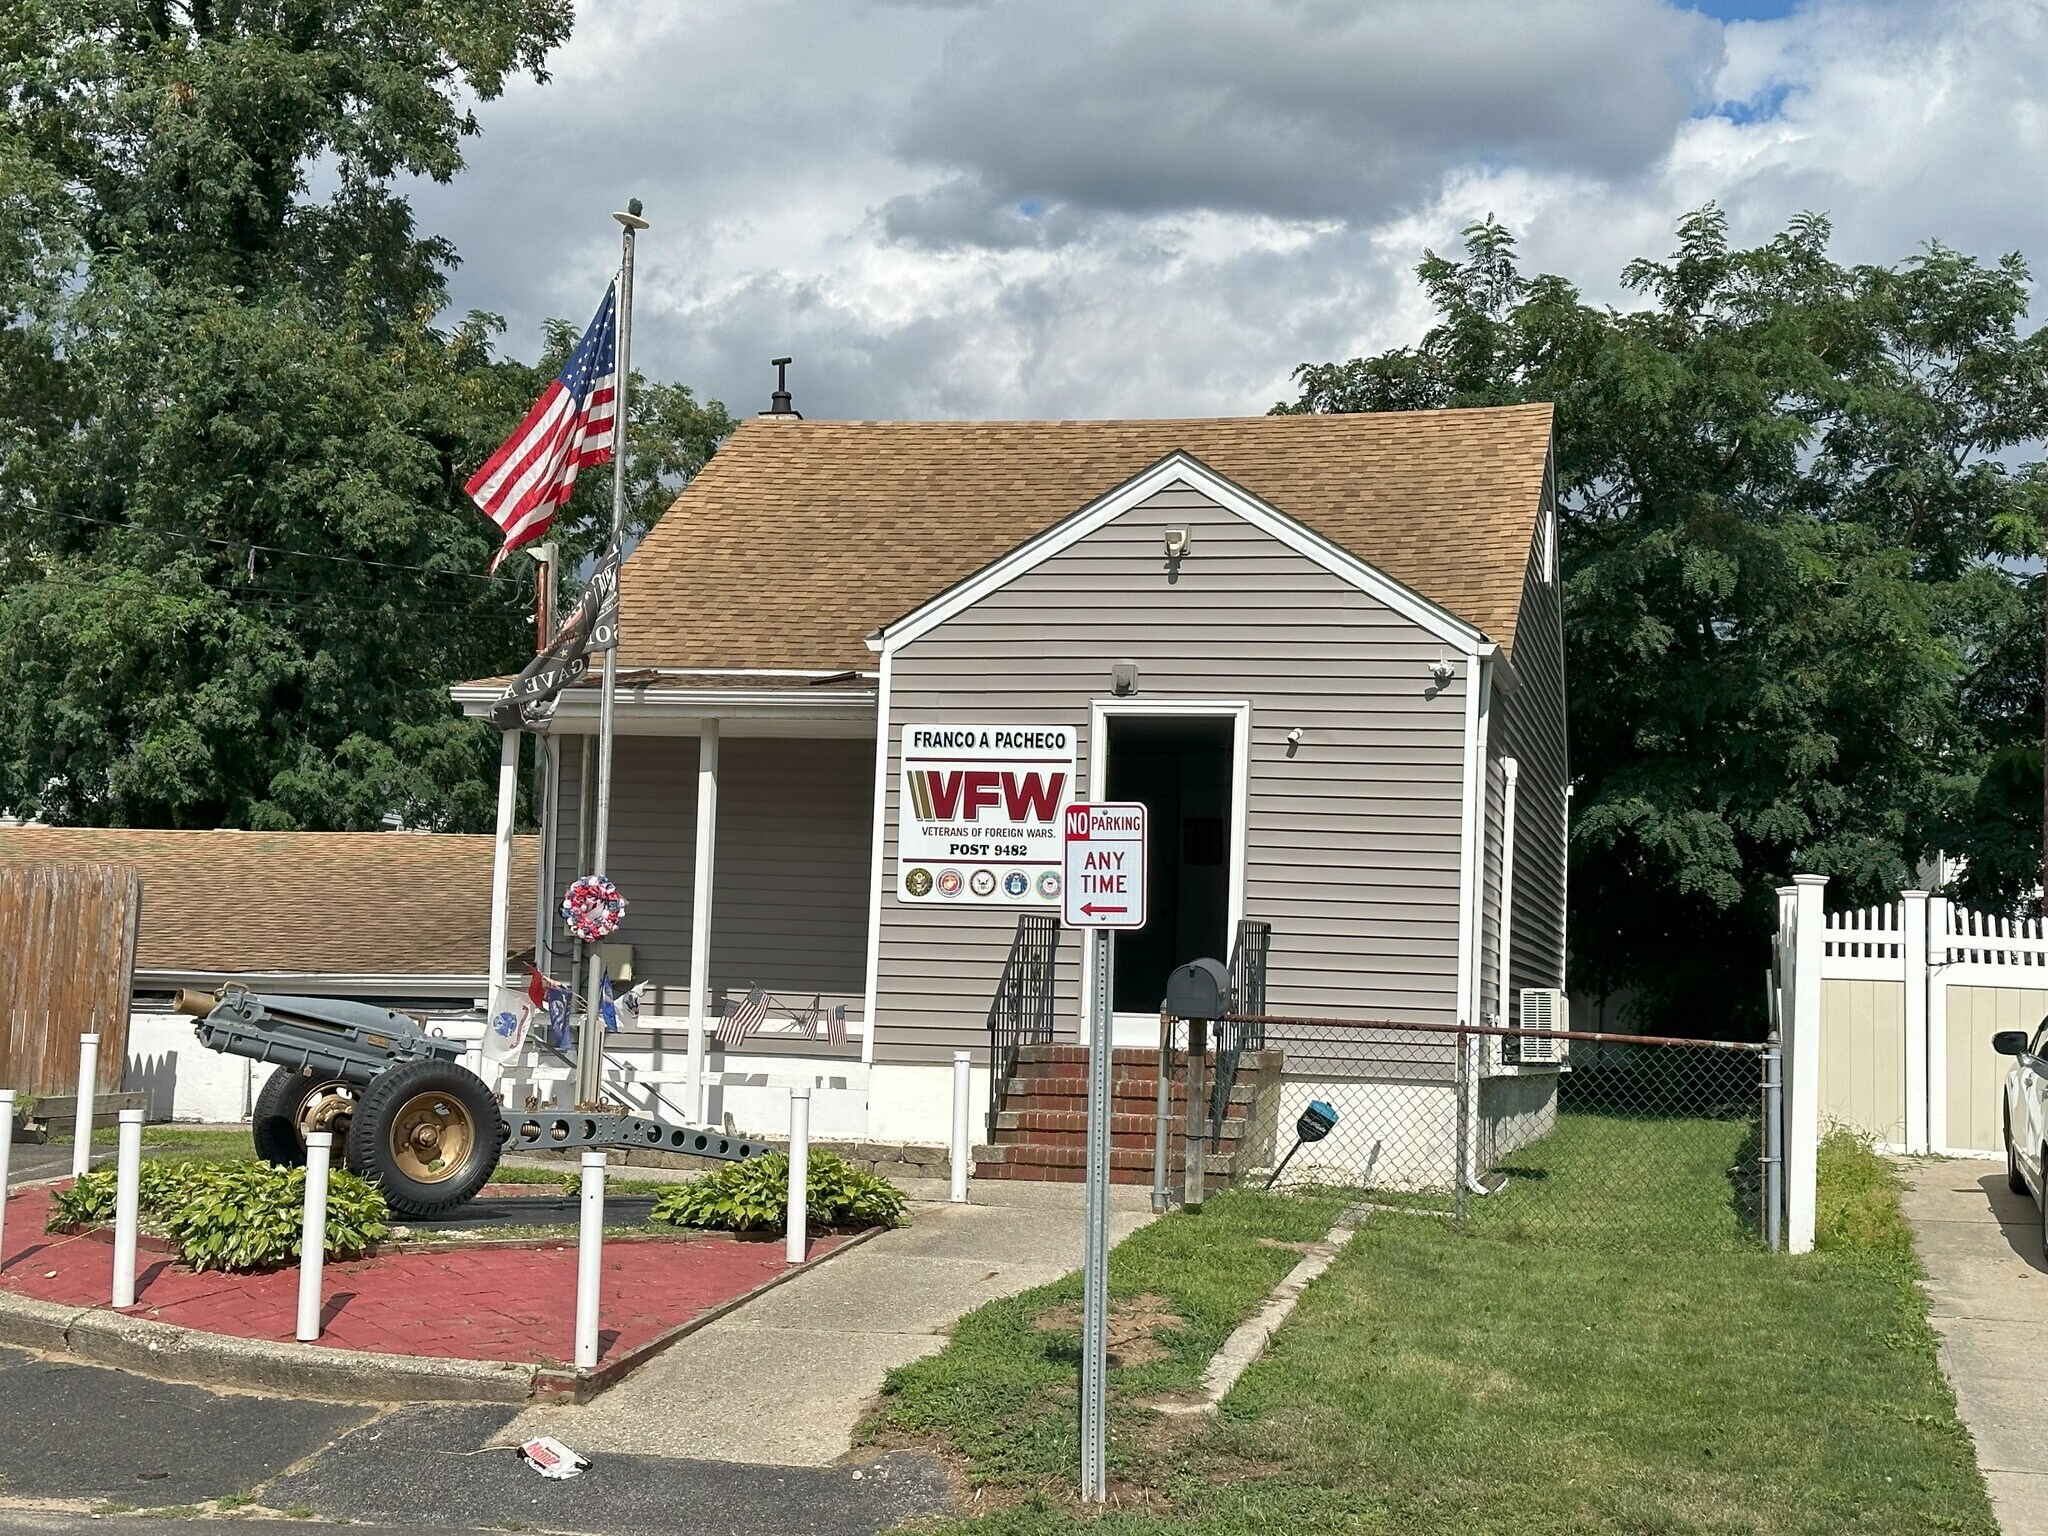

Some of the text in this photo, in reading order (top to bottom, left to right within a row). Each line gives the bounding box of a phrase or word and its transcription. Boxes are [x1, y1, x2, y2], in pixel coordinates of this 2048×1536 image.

[914, 731, 1066, 749] FRANCO A PACHECO
[926, 771, 1067, 823] VFW
[922, 827, 968, 837] VETERANS
[971, 827, 982, 837] OF
[985, 828, 1023, 838] FOREIGN
[1067, 811, 1141, 835] NO PARKING
[949, 843, 1028, 857] POST 9482
[1084, 851, 1125, 870] ANY
[1080, 874, 1127, 893] TIME
